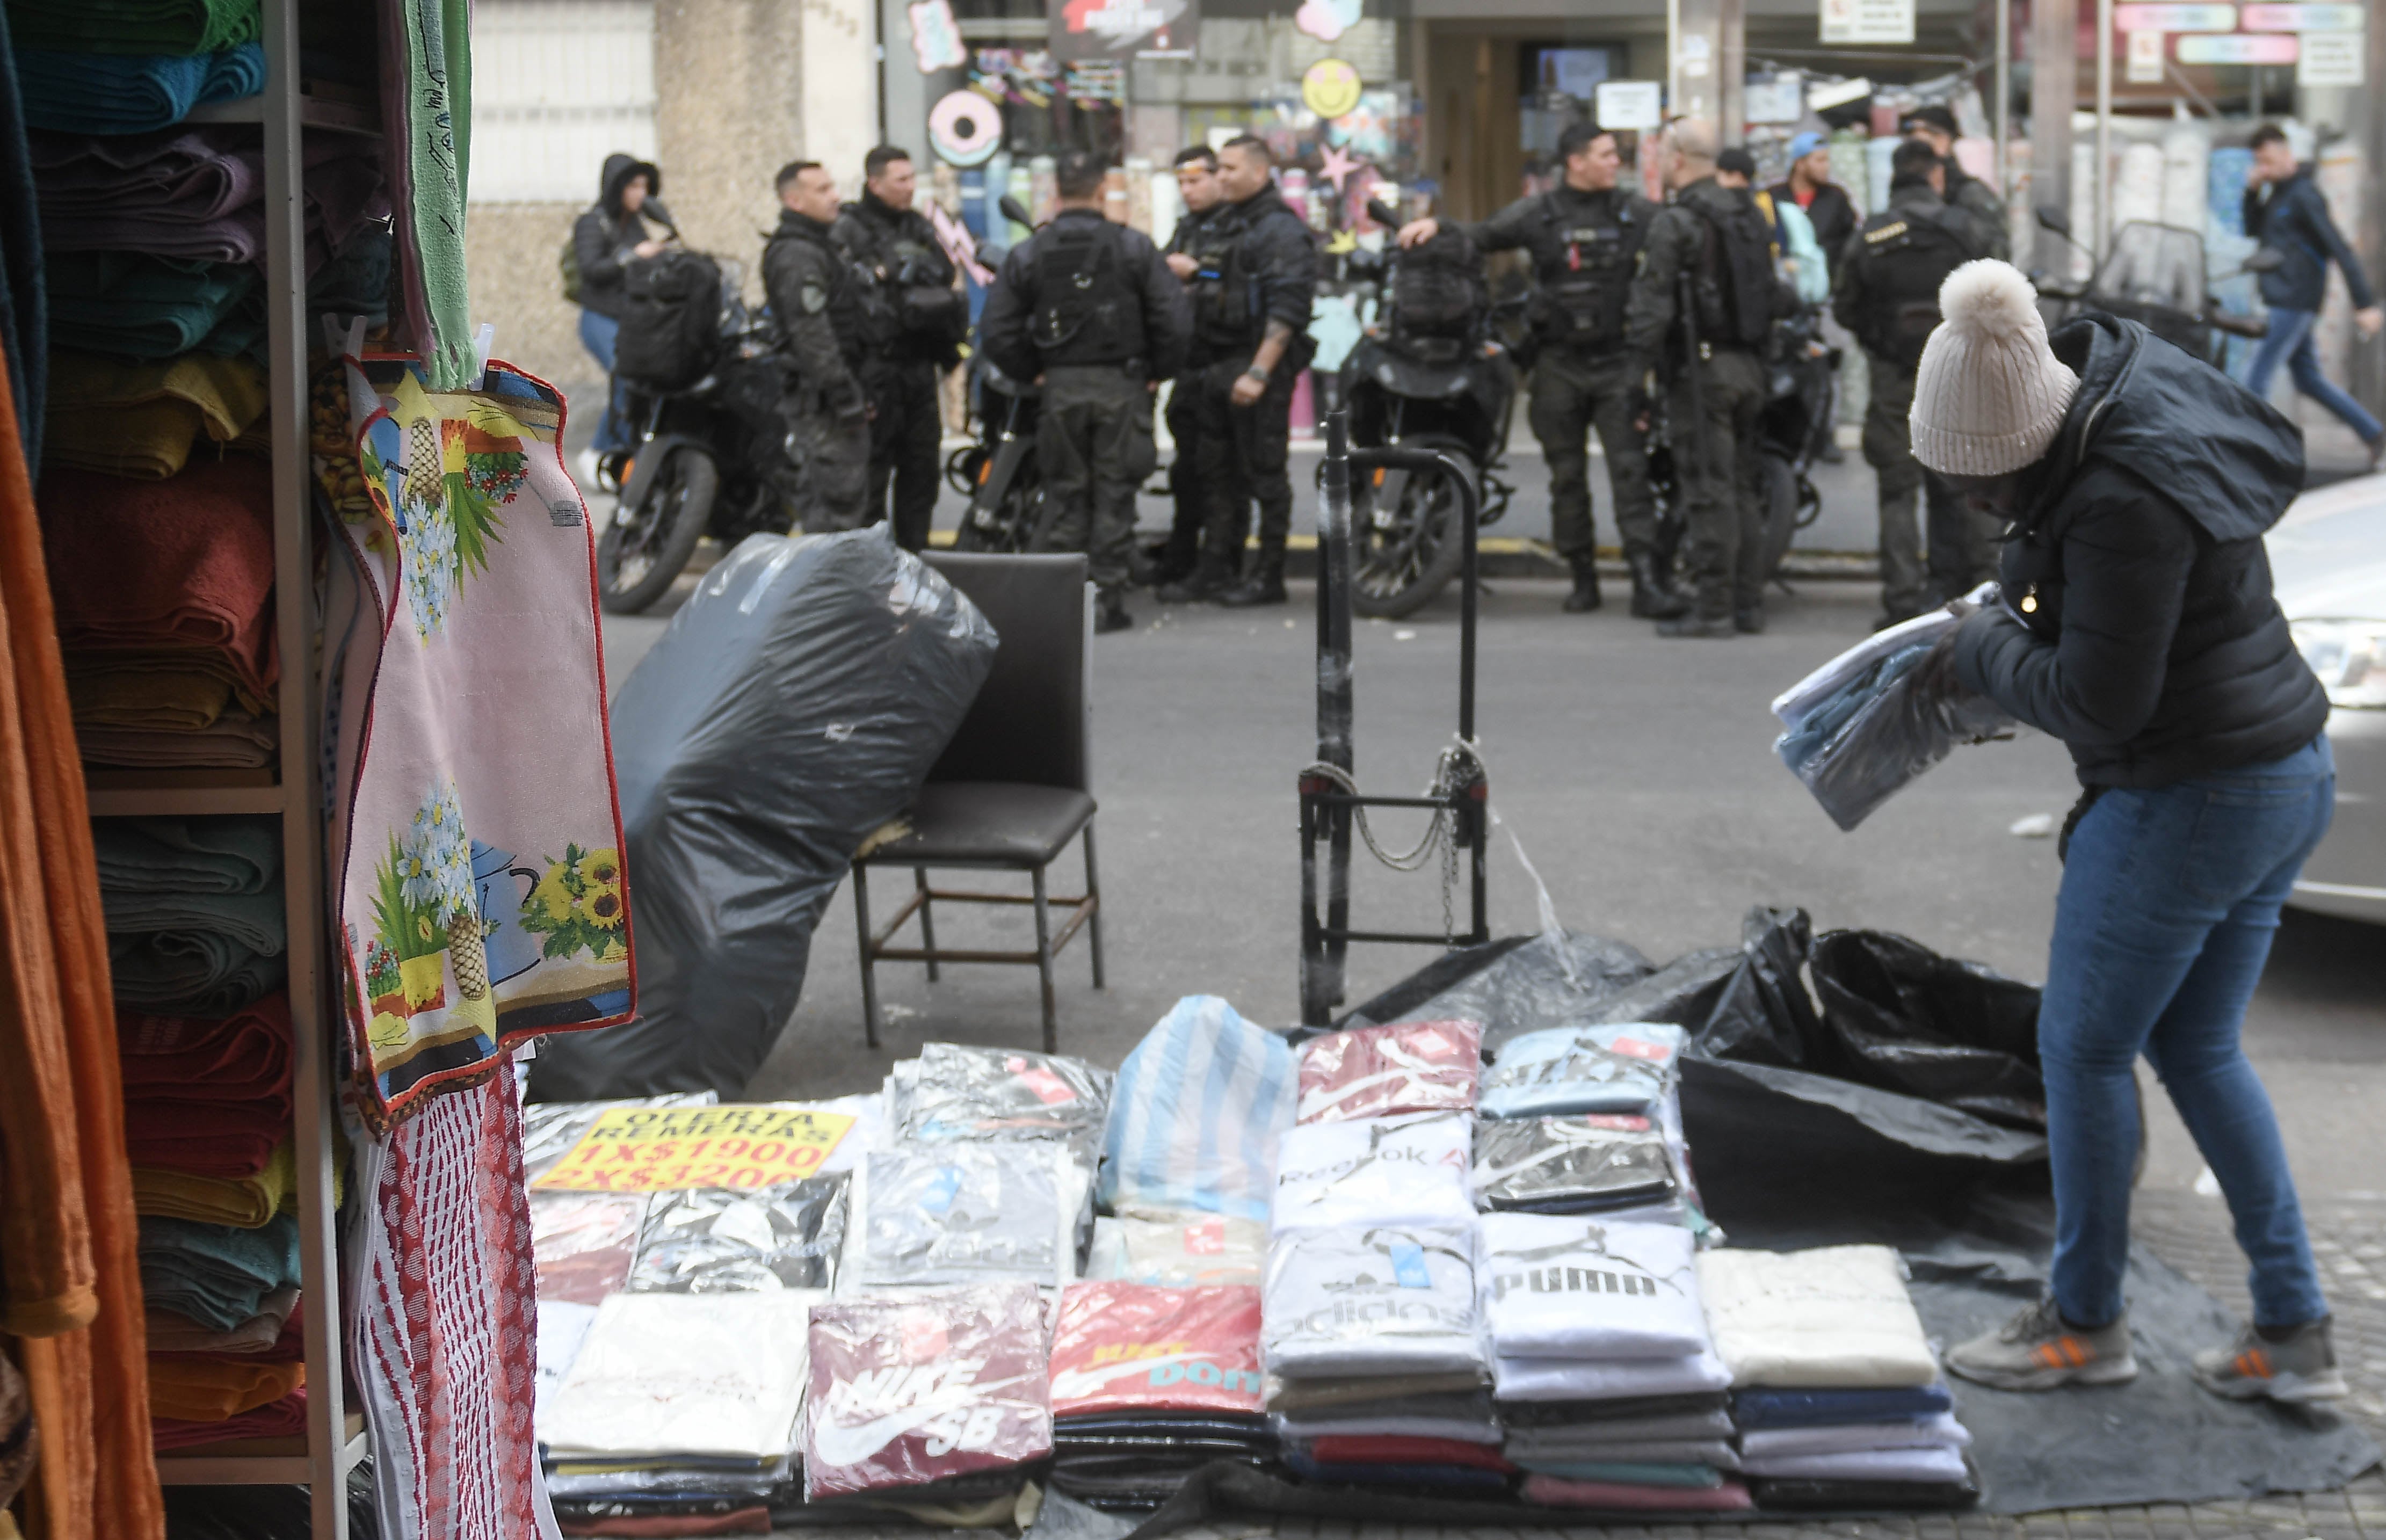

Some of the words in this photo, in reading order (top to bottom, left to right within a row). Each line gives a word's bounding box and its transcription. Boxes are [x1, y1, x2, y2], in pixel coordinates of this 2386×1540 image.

[626, 1110, 814, 1125] OFERTA
[592, 1124, 830, 1143] REMERAS
[579, 1138, 822, 1168] 1X$1900
[1495, 1267, 1657, 1303] PUMA
[1083, 1340, 1193, 1368] JUST
[836, 1357, 990, 1416] NIKE
[925, 1406, 1005, 1457] SB
